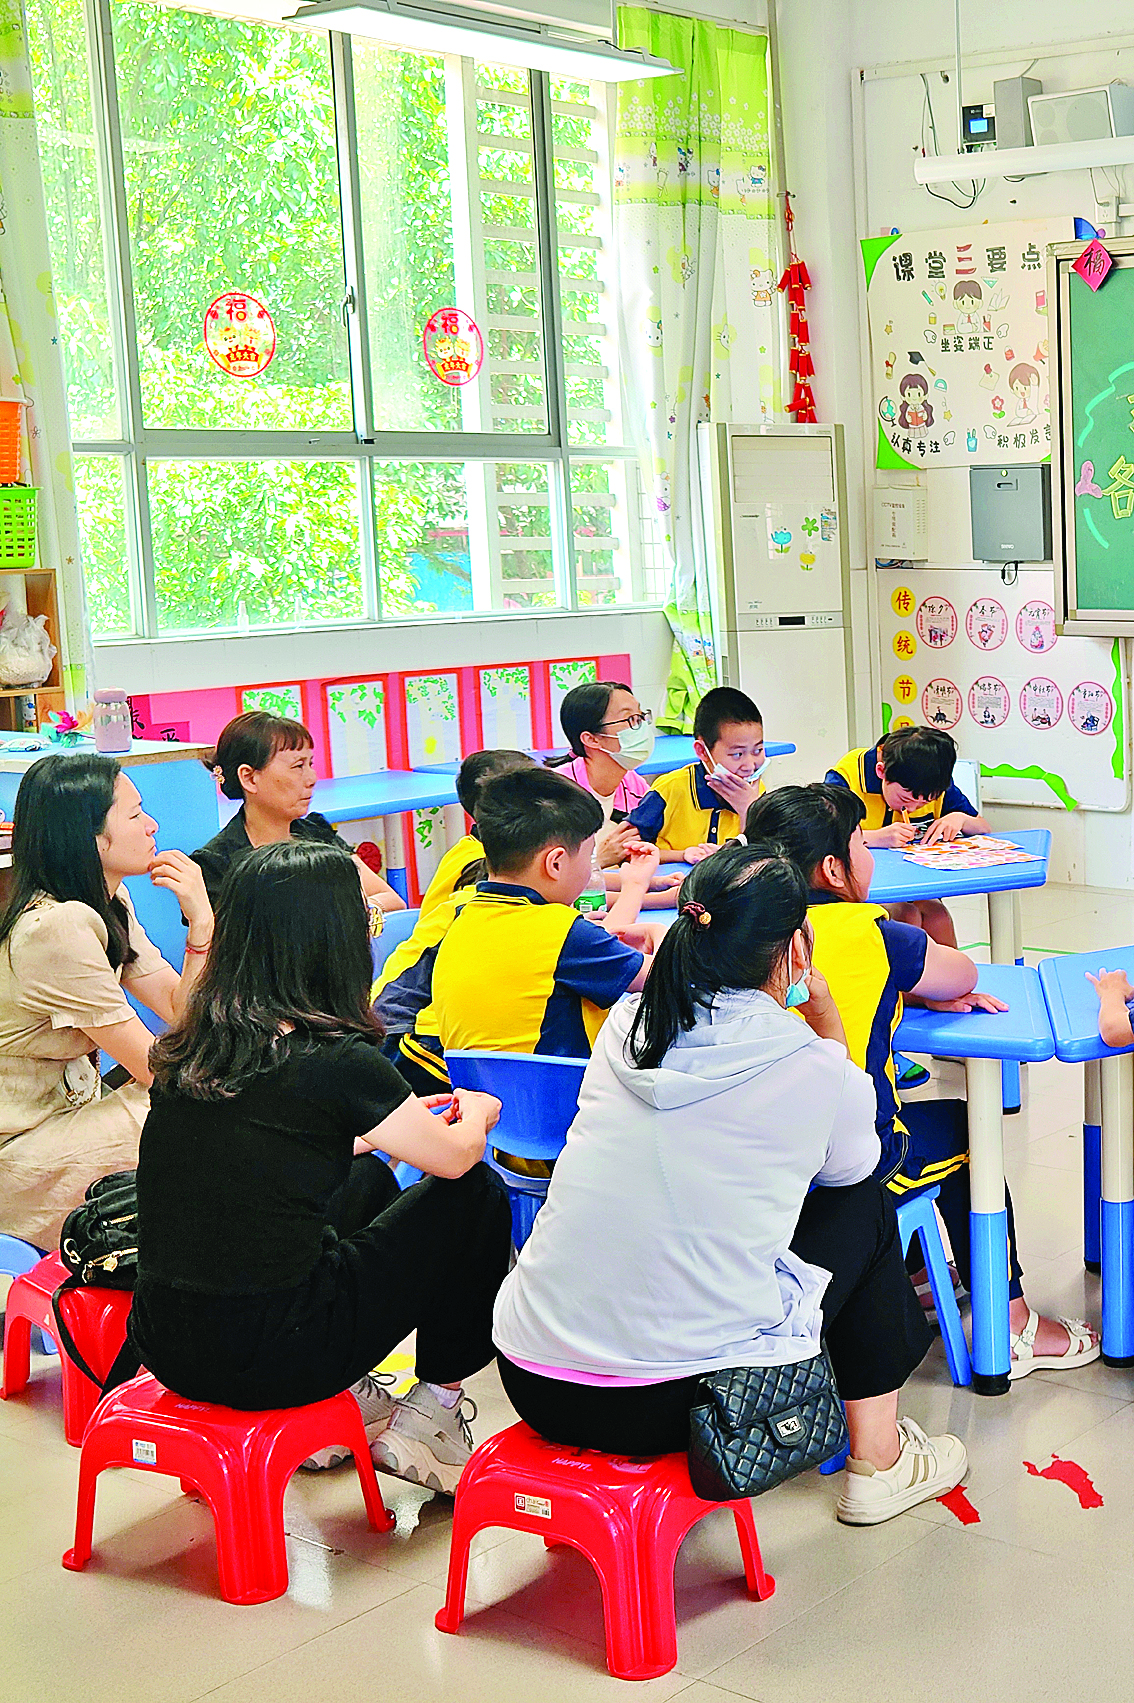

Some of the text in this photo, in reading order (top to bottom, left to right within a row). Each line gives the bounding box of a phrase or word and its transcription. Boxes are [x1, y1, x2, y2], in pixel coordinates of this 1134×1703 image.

[892, 243, 1043, 281] 课堂三要点
[1084, 248, 1105, 276] 福
[941, 335, 995, 353] 坐姿端正
[891, 432, 941, 457] 认真专注
